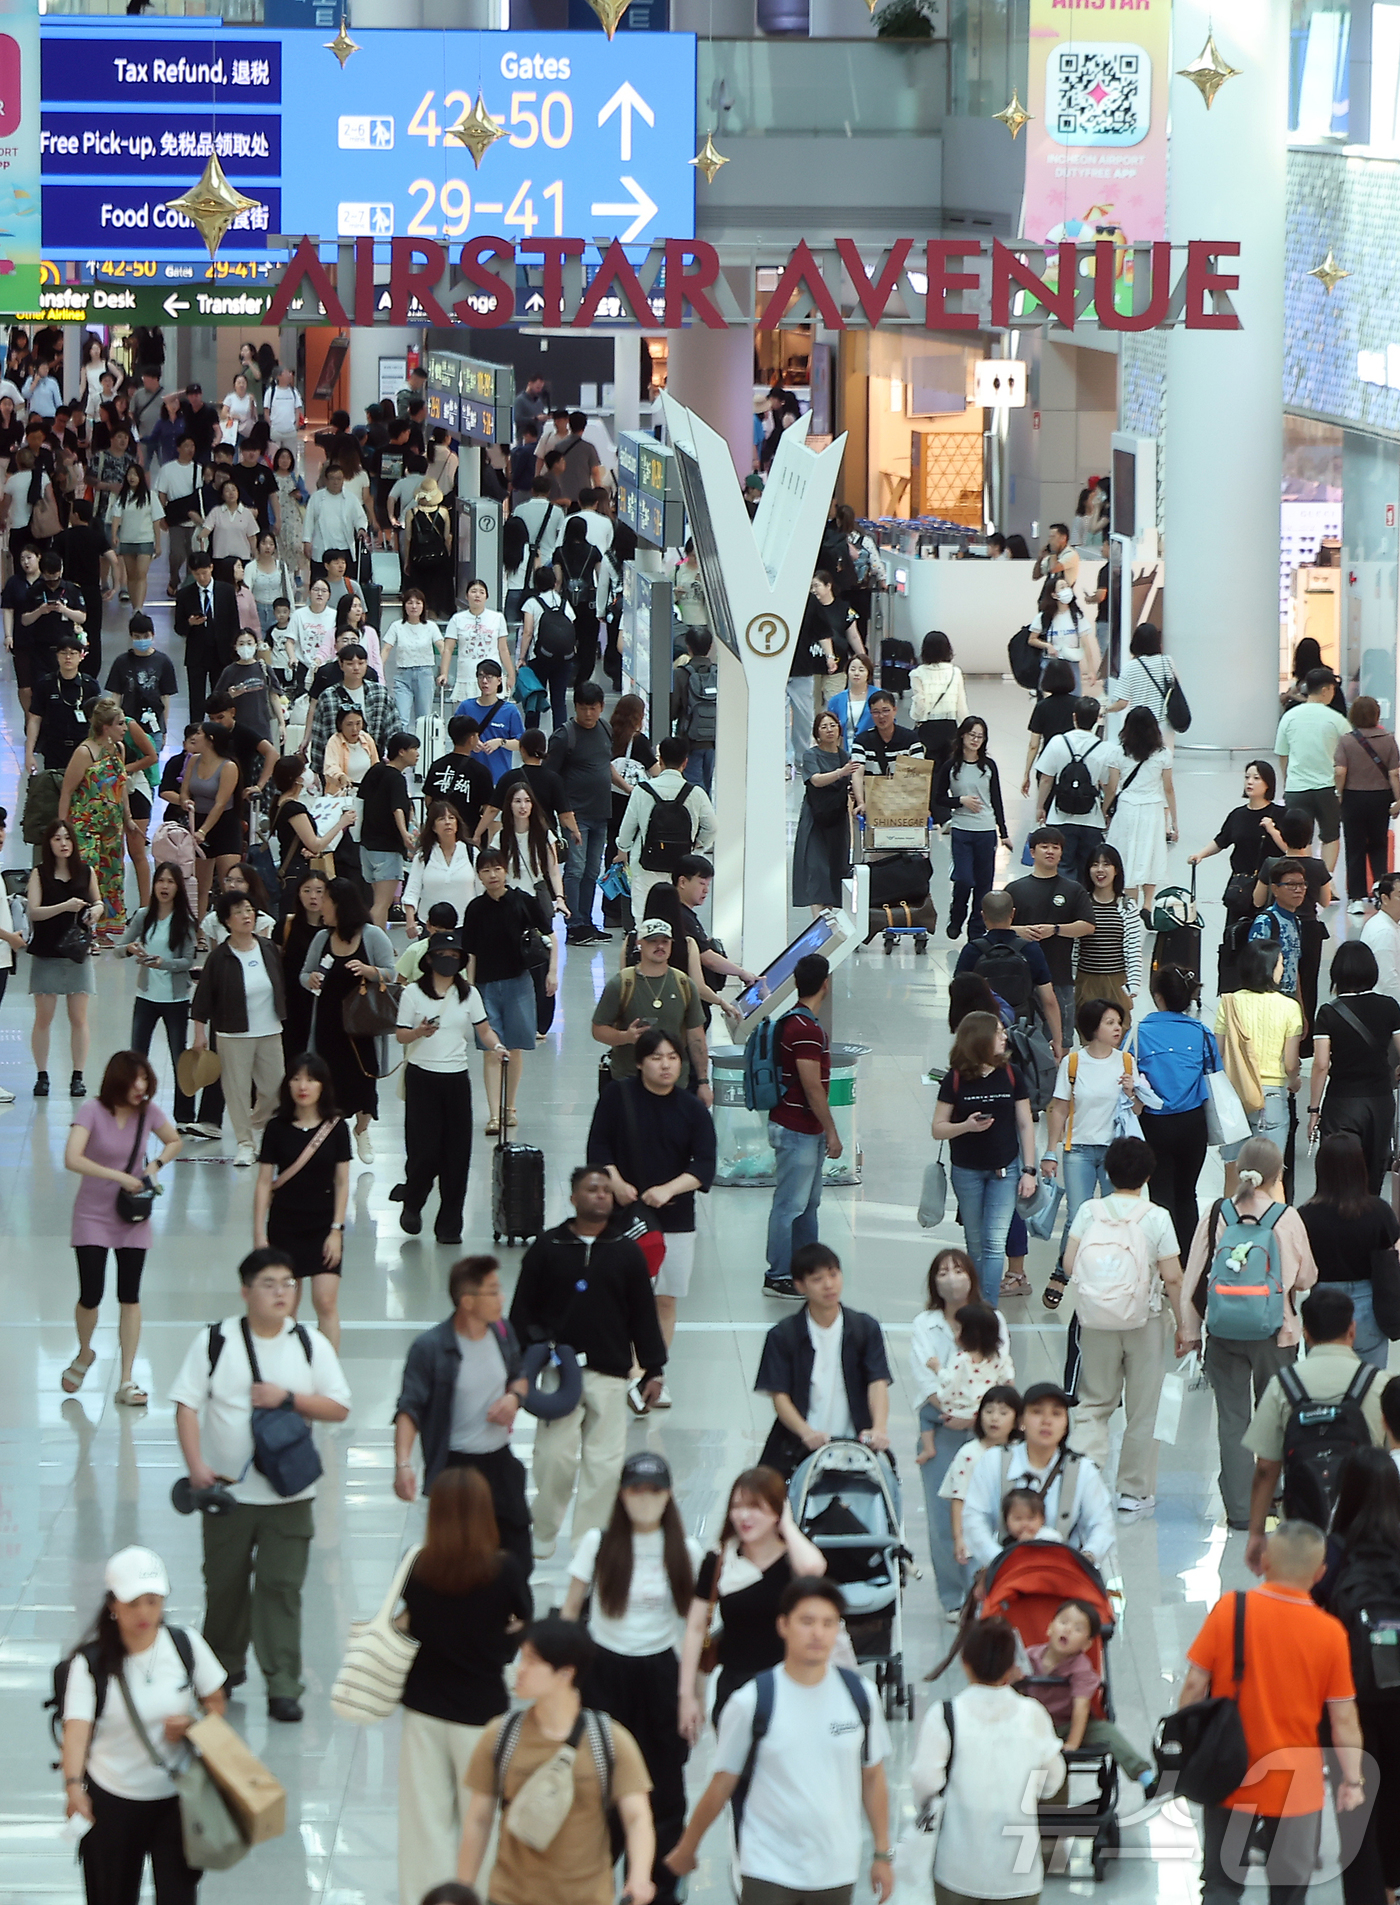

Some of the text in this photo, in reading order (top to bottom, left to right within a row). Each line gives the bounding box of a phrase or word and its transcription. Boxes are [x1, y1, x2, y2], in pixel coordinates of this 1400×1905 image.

[114, 57, 270, 85] Tax Refund, 退税
[500, 51, 572, 80] Gates
[40, 130, 269, 160] Free Pick-up, 免税品领取处
[1113, 168, 1137, 178] APP
[101, 203, 148, 228] Food
[153, 204, 195, 228] Cou
[407, 178, 563, 236] 29-41
[260, 234, 1242, 332] AIRSTAR AVENUE
[47, 308, 86, 321] Airlines
[93, 289, 137, 309] Desk
[196, 293, 264, 314] Transfer
